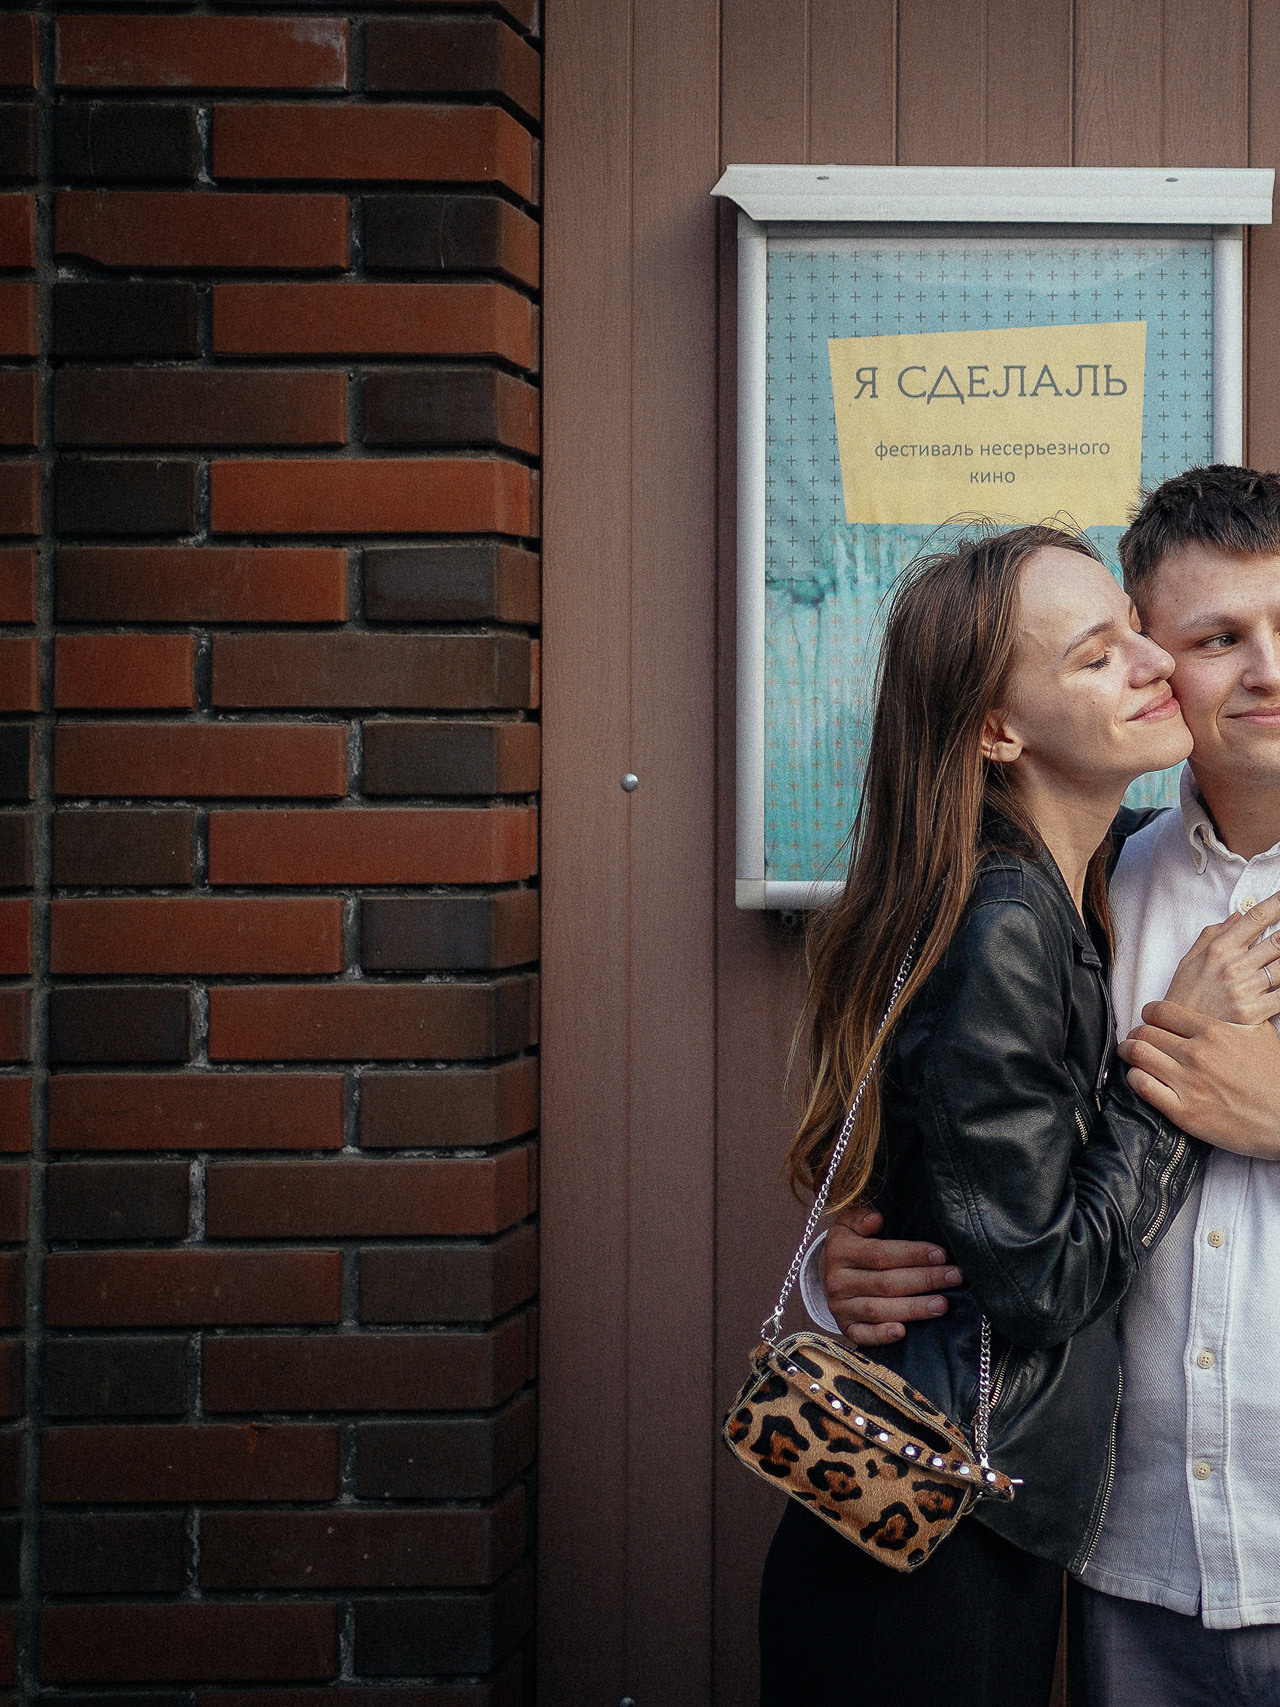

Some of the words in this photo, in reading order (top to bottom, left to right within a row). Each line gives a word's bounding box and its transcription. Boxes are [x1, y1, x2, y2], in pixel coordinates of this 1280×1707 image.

[854, 366, 879, 399] Я
[897, 363, 1128, 405] СДЕЛАЛЬ
[874, 439, 974, 461] фестиваль
[979, 440, 1110, 460] несерьезного
[969, 470, 1016, 484] кино
